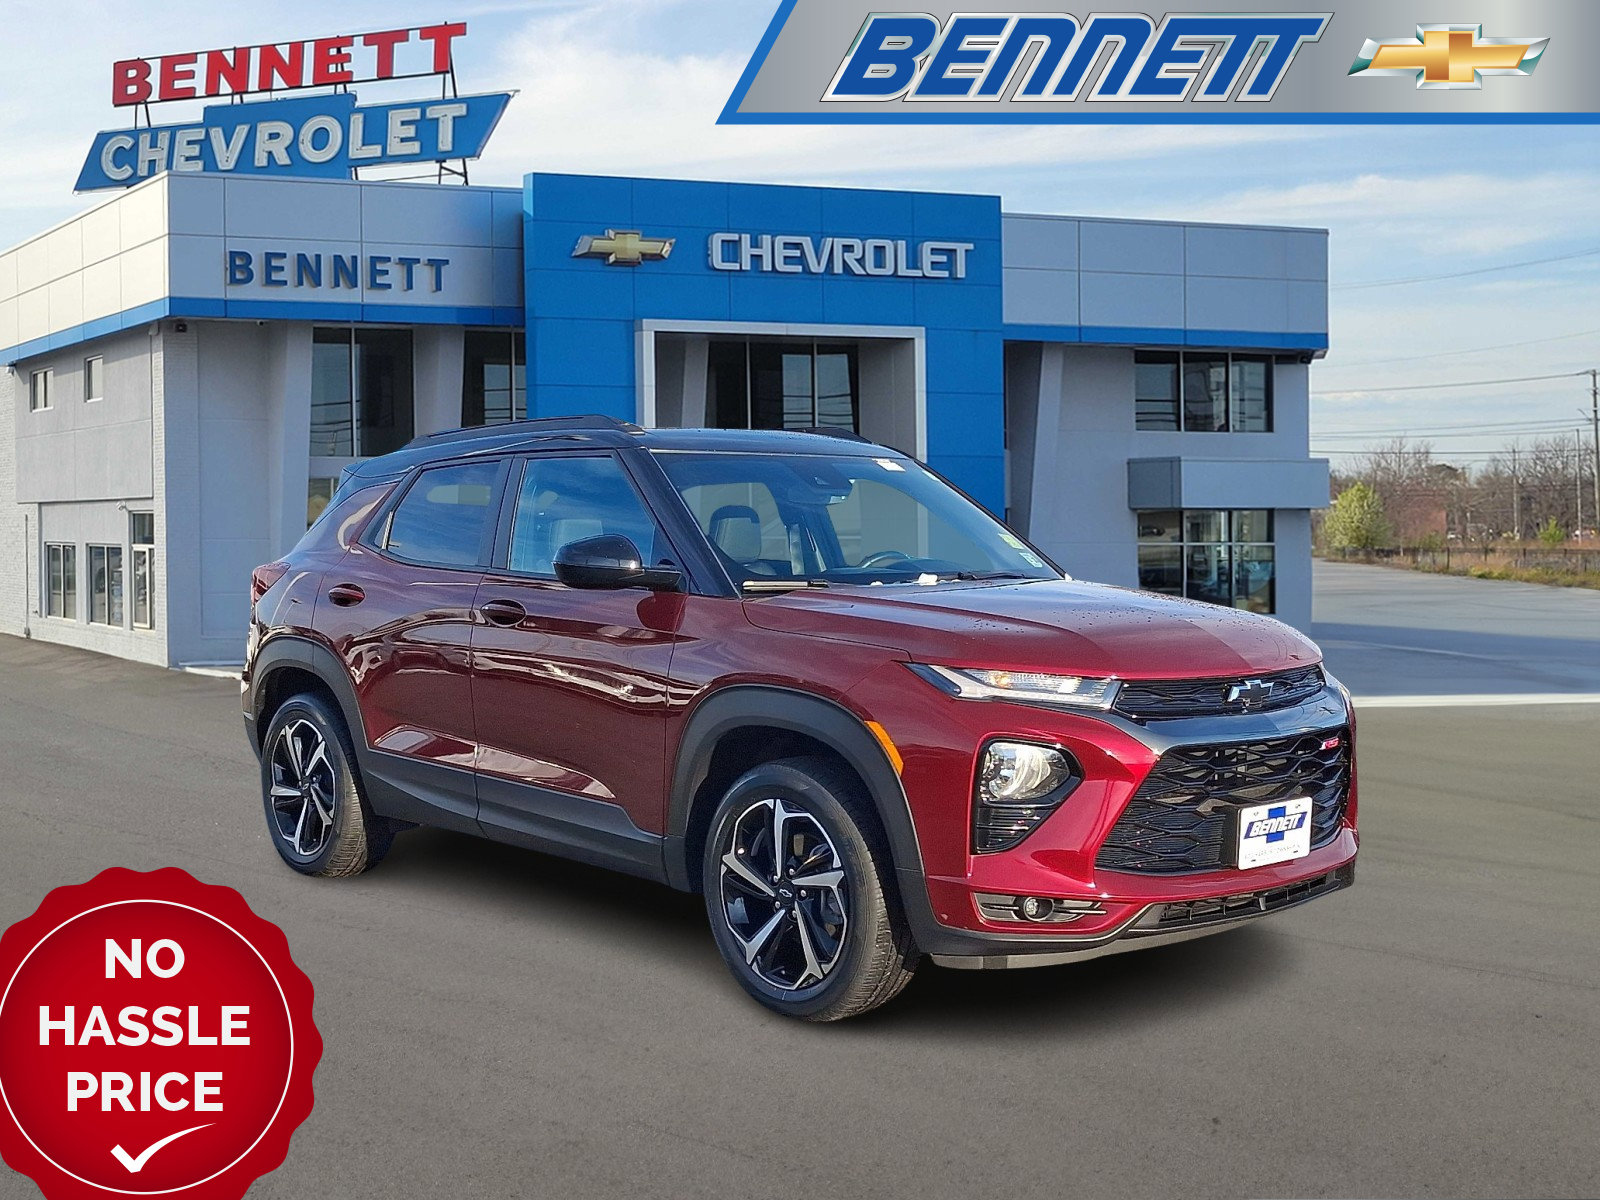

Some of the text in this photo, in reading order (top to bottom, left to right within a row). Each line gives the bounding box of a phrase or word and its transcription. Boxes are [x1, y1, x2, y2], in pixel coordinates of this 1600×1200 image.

[112, 22, 467, 107] BENNETT
[100, 103, 468, 181] CHEVROLET
[226, 250, 450, 292] BENNETT
[708, 232, 974, 279] CHEVROLET
[1249, 814, 1302, 837] BENNETT
